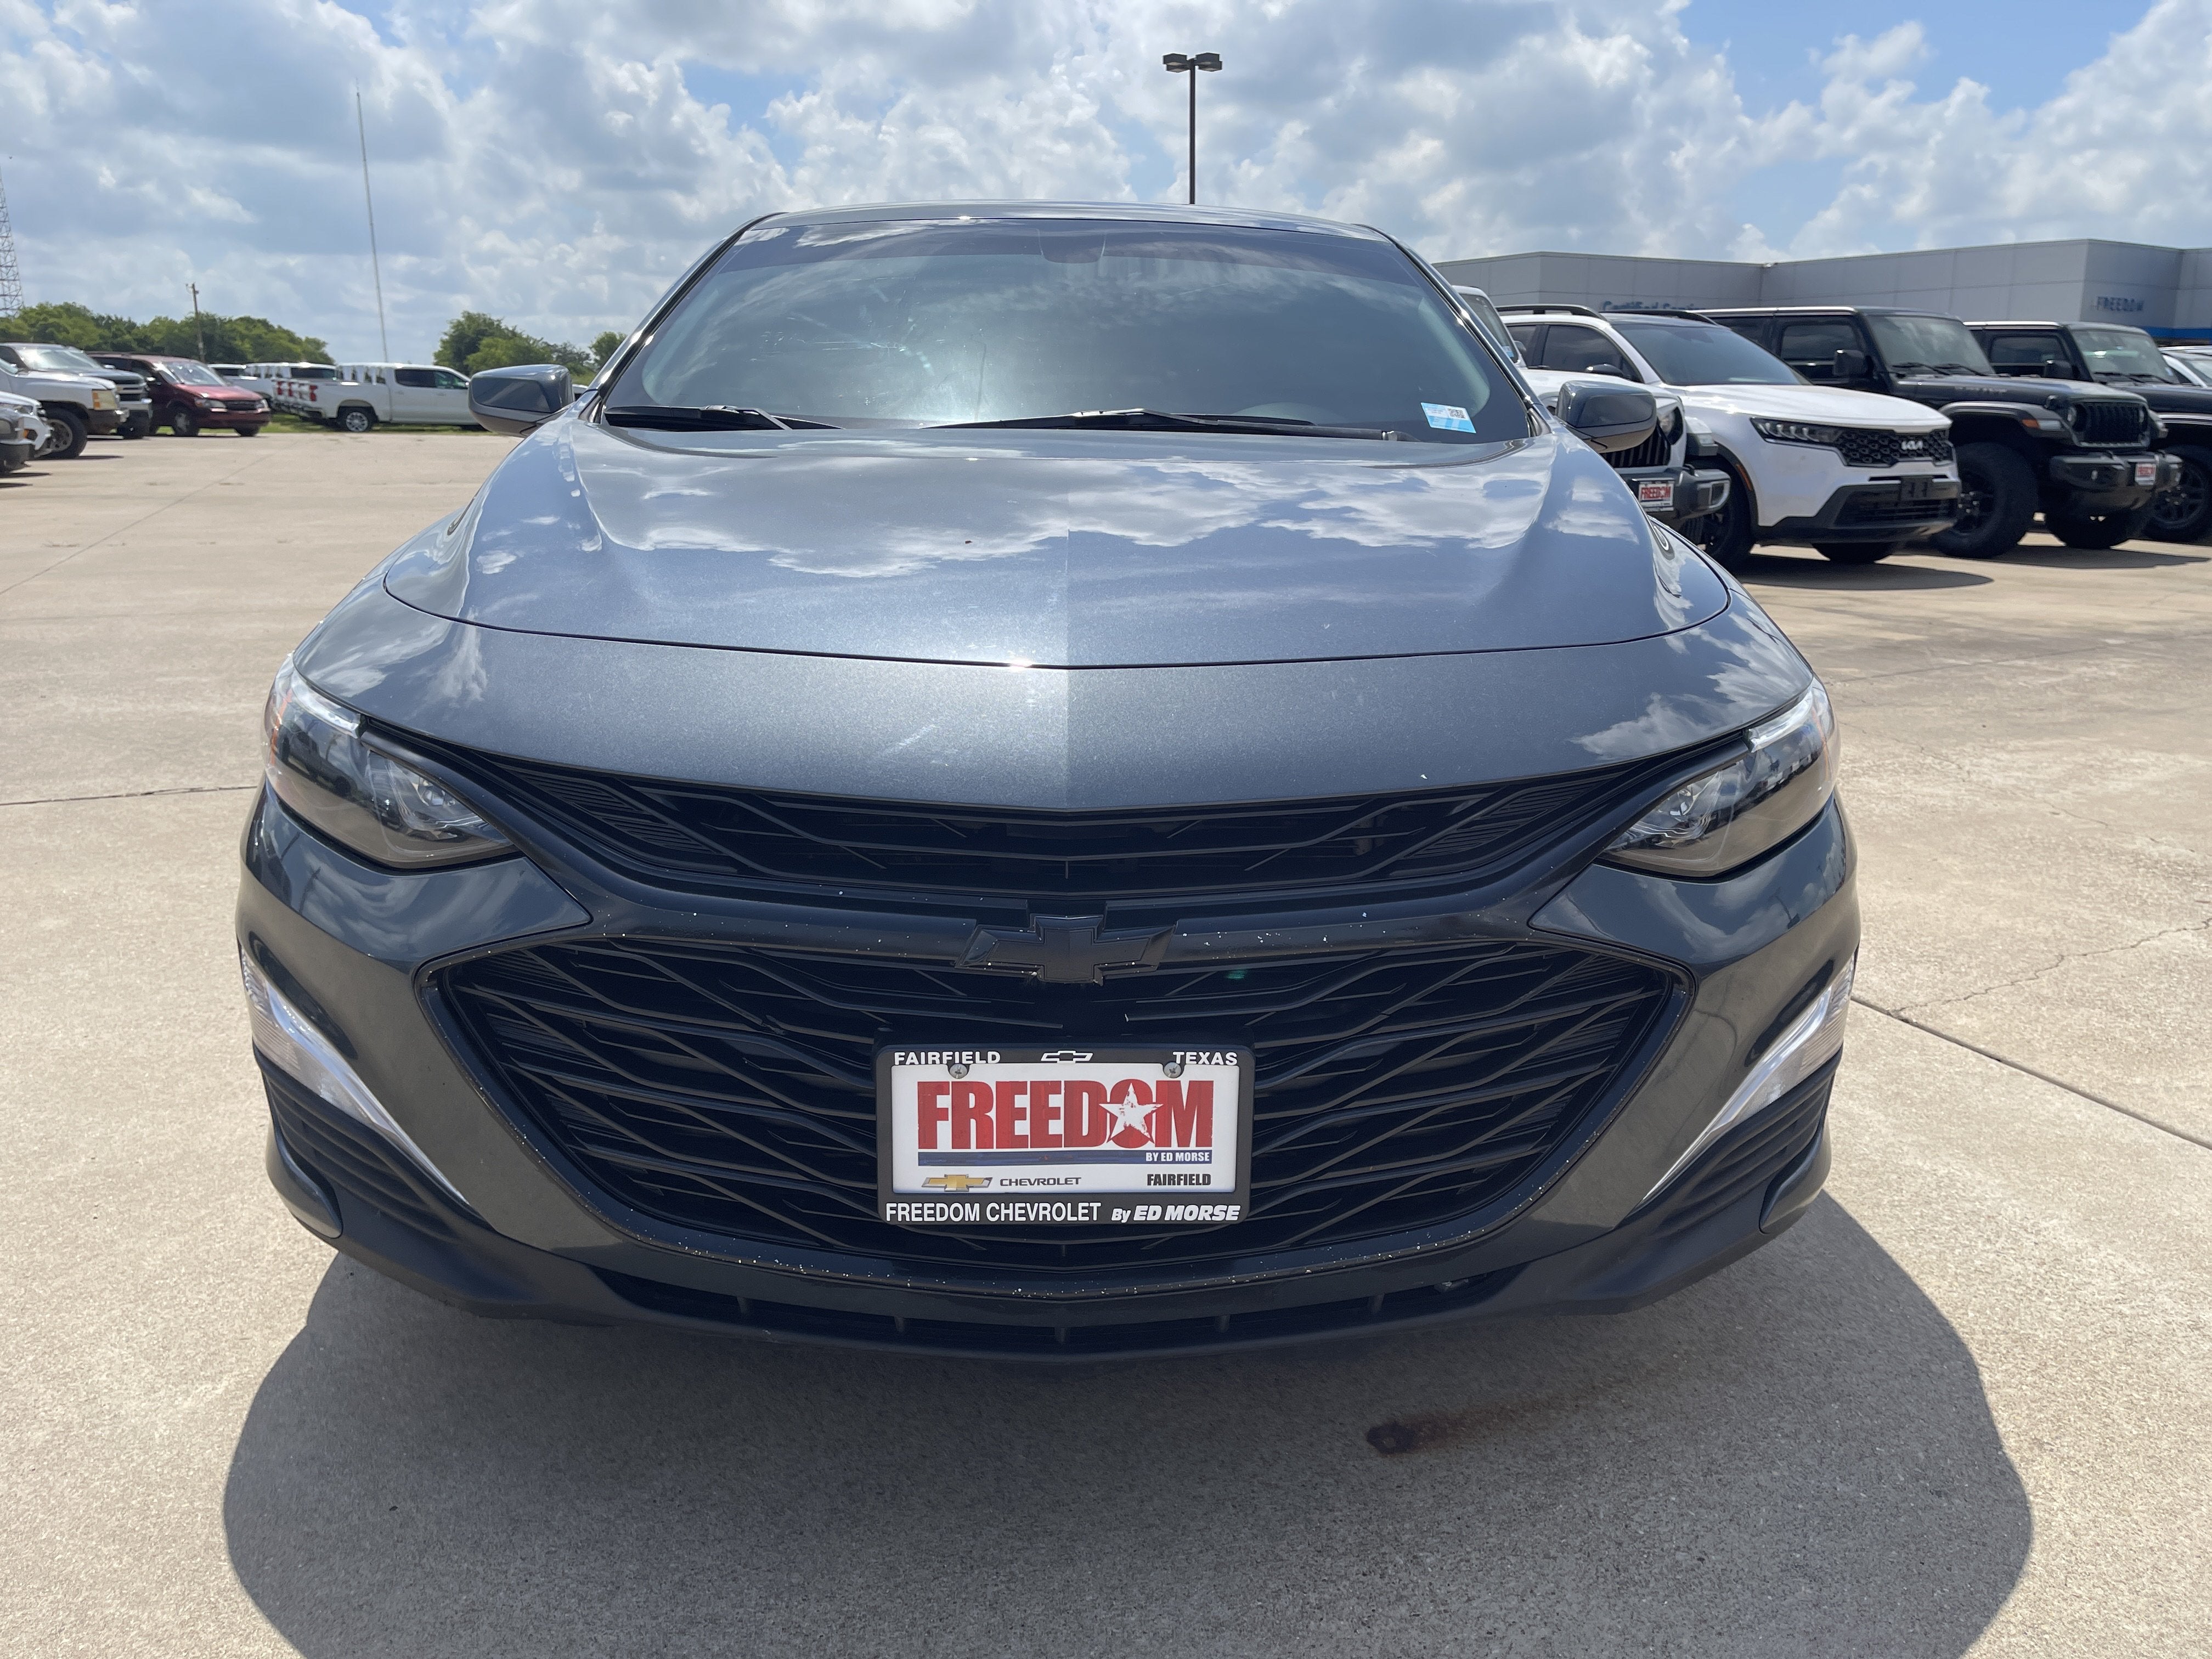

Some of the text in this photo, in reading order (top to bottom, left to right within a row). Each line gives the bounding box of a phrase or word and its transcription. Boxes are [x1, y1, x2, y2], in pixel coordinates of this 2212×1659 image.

[894, 1051, 1238, 1065] FAIRFIELD TEXAS
[917, 1079, 1214, 1150] FREEDOM
[1146, 1152, 1210, 1162] BY ED MORSE
[1000, 1176, 1082, 1187] CHEVROLET
[1147, 1173, 1211, 1186] FAIRFIELD
[886, 1202, 1241, 1223] FREEDOM CHEVROLET By ED MORSE
